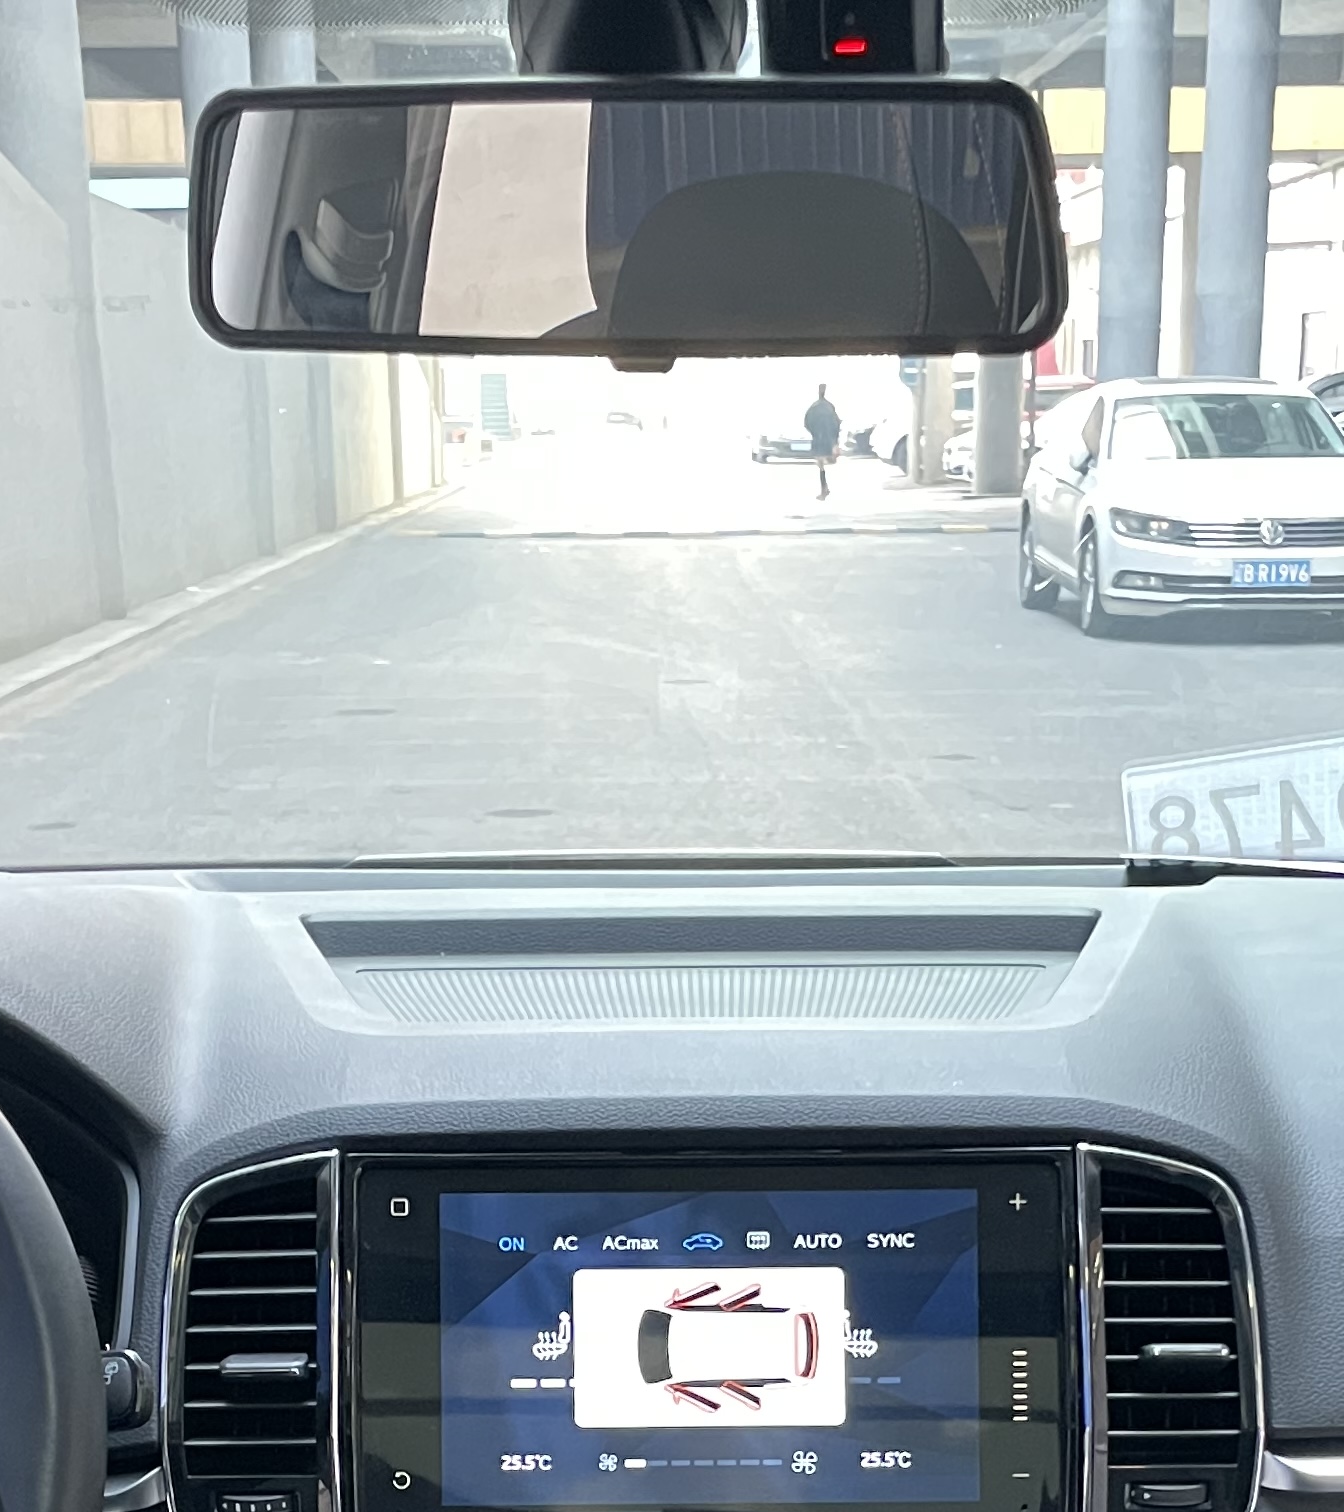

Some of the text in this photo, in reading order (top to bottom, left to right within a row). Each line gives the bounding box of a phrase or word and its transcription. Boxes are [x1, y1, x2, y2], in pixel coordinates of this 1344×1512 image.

[498, 1232, 916, 1251] ON AC ACmax AUTO SYNC
[500, 1453, 553, 1471] 25.5°C
[860, 1450, 913, 1469] 25.5°C
